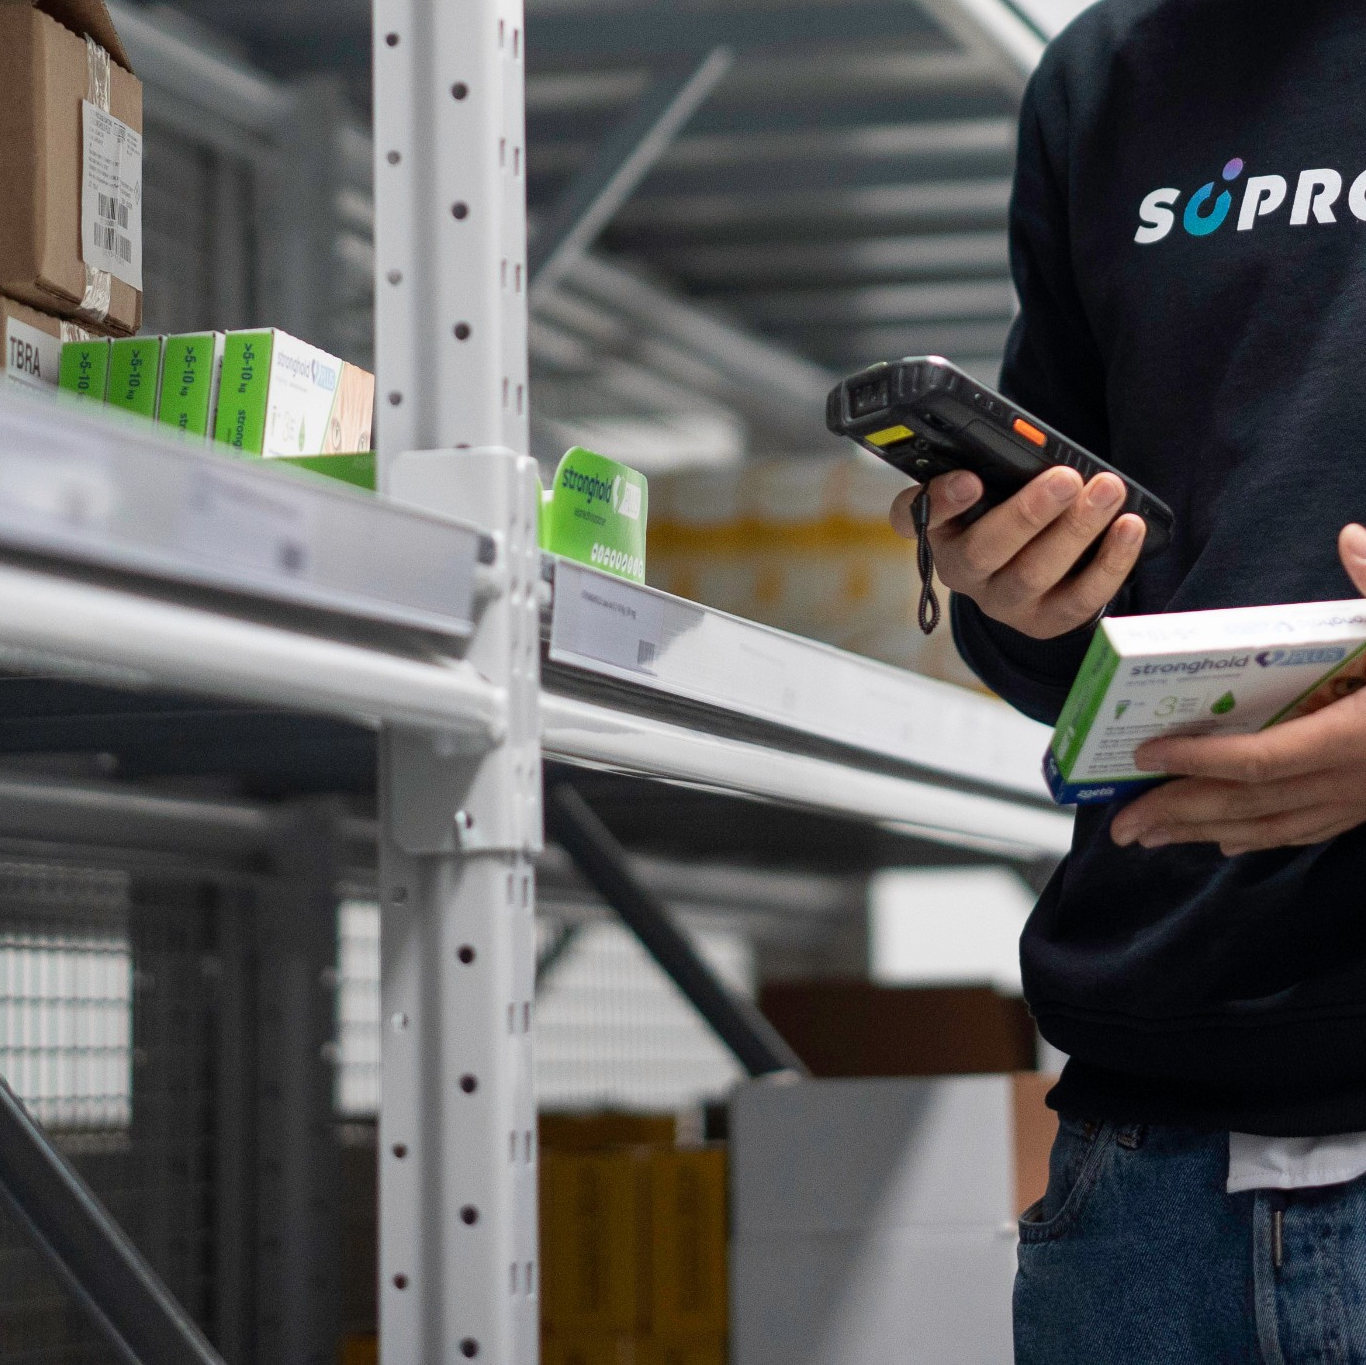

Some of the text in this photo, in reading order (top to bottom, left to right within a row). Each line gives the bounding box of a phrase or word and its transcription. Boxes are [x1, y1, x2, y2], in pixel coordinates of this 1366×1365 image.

[10, 336, 41, 377] TBRA
[277, 351, 310, 378] stronghold
[562, 465, 613, 503] stronghold
[1130, 655, 1250, 677] stronghold
[1154, 696, 1177, 718] 3
